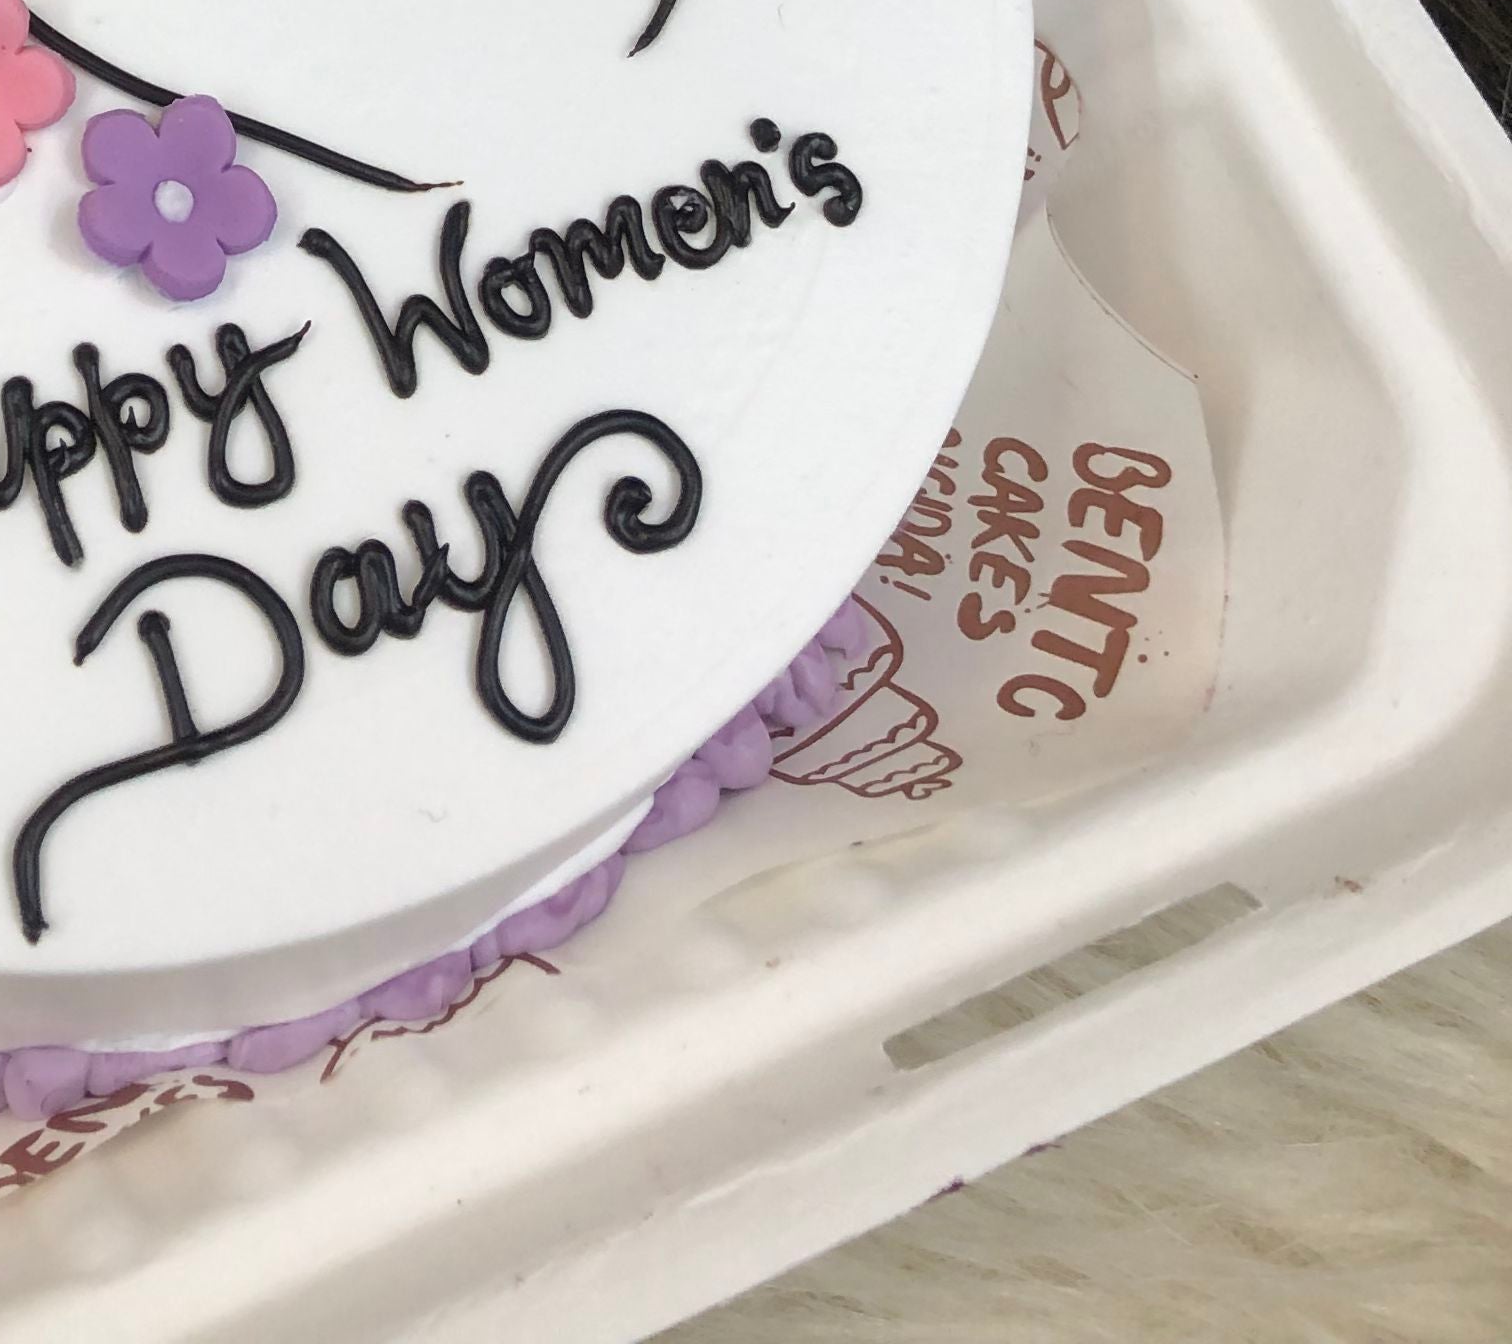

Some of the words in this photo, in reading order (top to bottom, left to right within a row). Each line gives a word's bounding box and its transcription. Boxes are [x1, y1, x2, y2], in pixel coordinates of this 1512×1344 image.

[299, 118, 864, 398] Women's
[12, 407, 703, 945] Day
[956, 436, 1049, 641] CAKES
